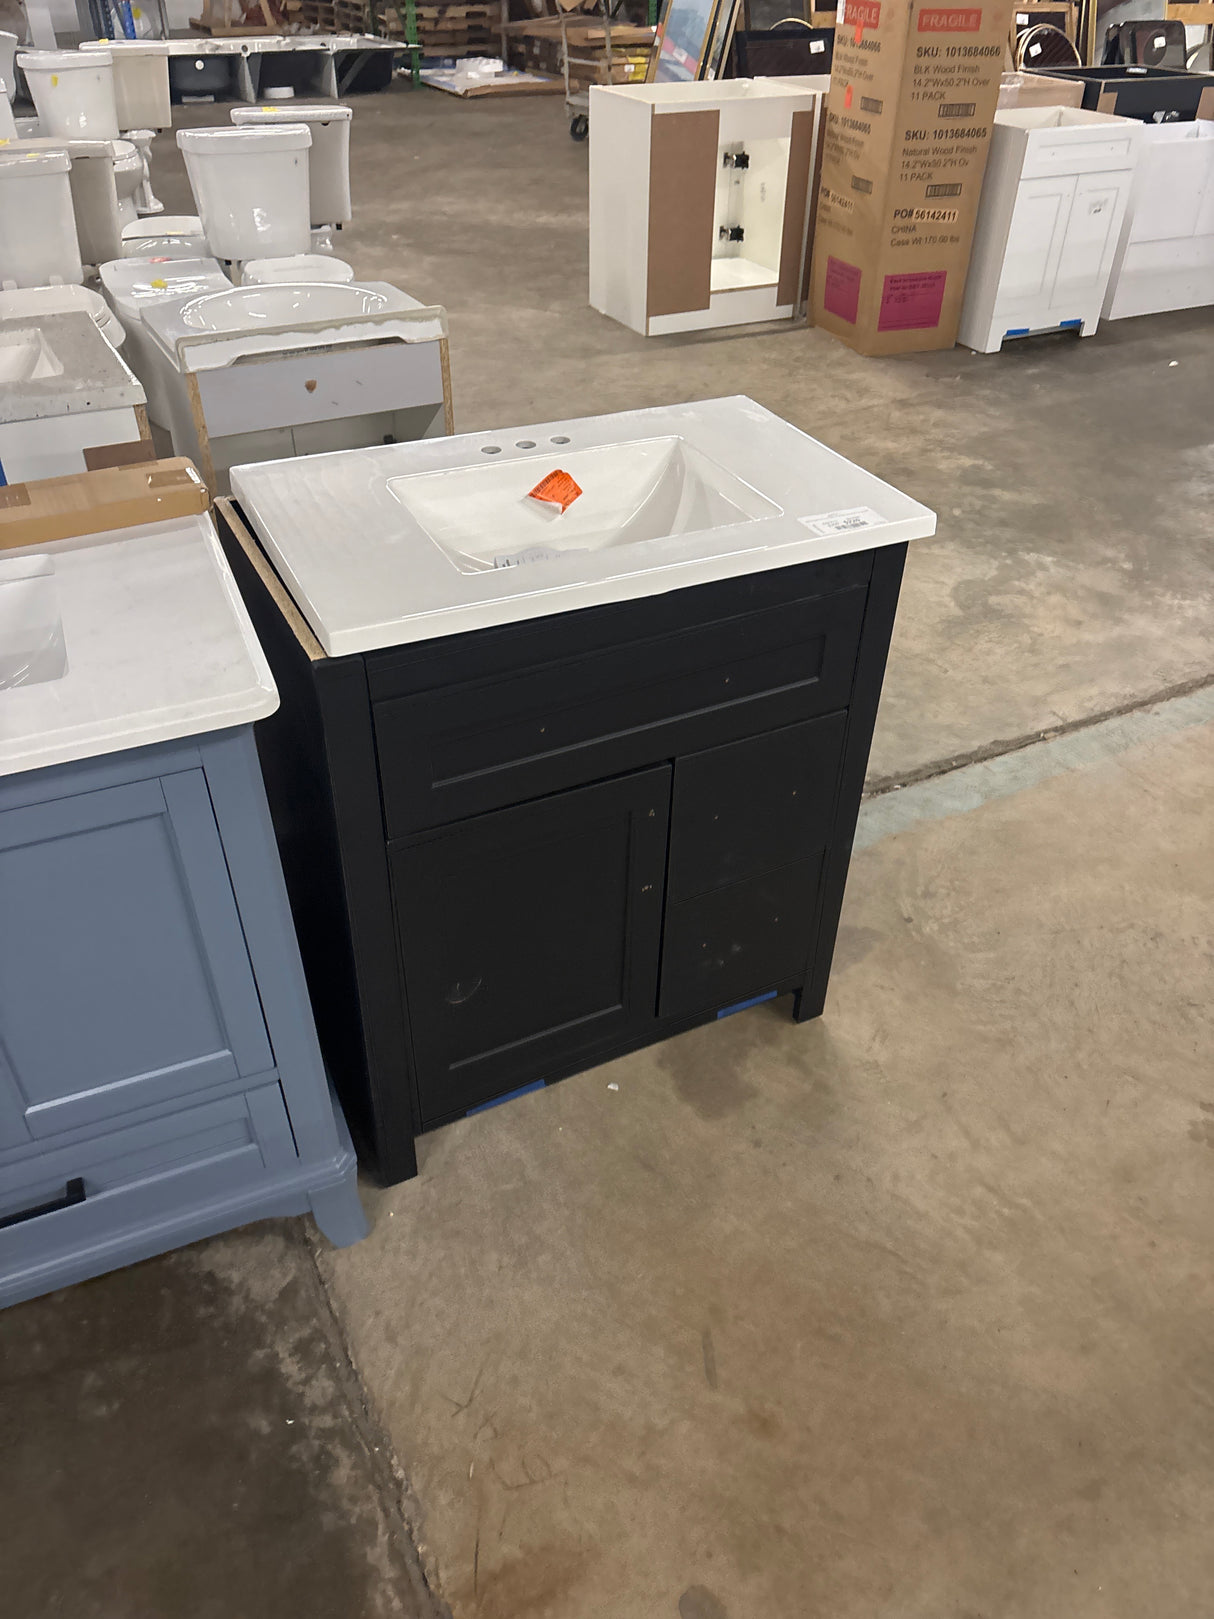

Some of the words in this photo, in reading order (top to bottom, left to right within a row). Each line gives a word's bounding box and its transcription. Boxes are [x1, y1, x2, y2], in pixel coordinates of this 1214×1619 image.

[845, 4, 878, 23] RAGILE
[922, 14, 977, 27] FRAGILE
[916, 46, 941, 58] SKU:
[946, 46, 1001, 57] 1013684066
[914, 64, 930, 74] BLK
[933, 64, 955, 74] Wood
[957, 64, 980, 74] Finish
[971, 78, 991, 87] Over
[922, 91, 946, 101] PACK
[904, 130, 930, 141] SKU:
[933, 127, 987, 140] 1013684065
[902, 148, 930, 157] Natural
[932, 146, 954, 156] Wood
[955, 146, 977, 155] Finish
[910, 172, 933, 181] PACK
[891, 225, 916, 234] CHINA
